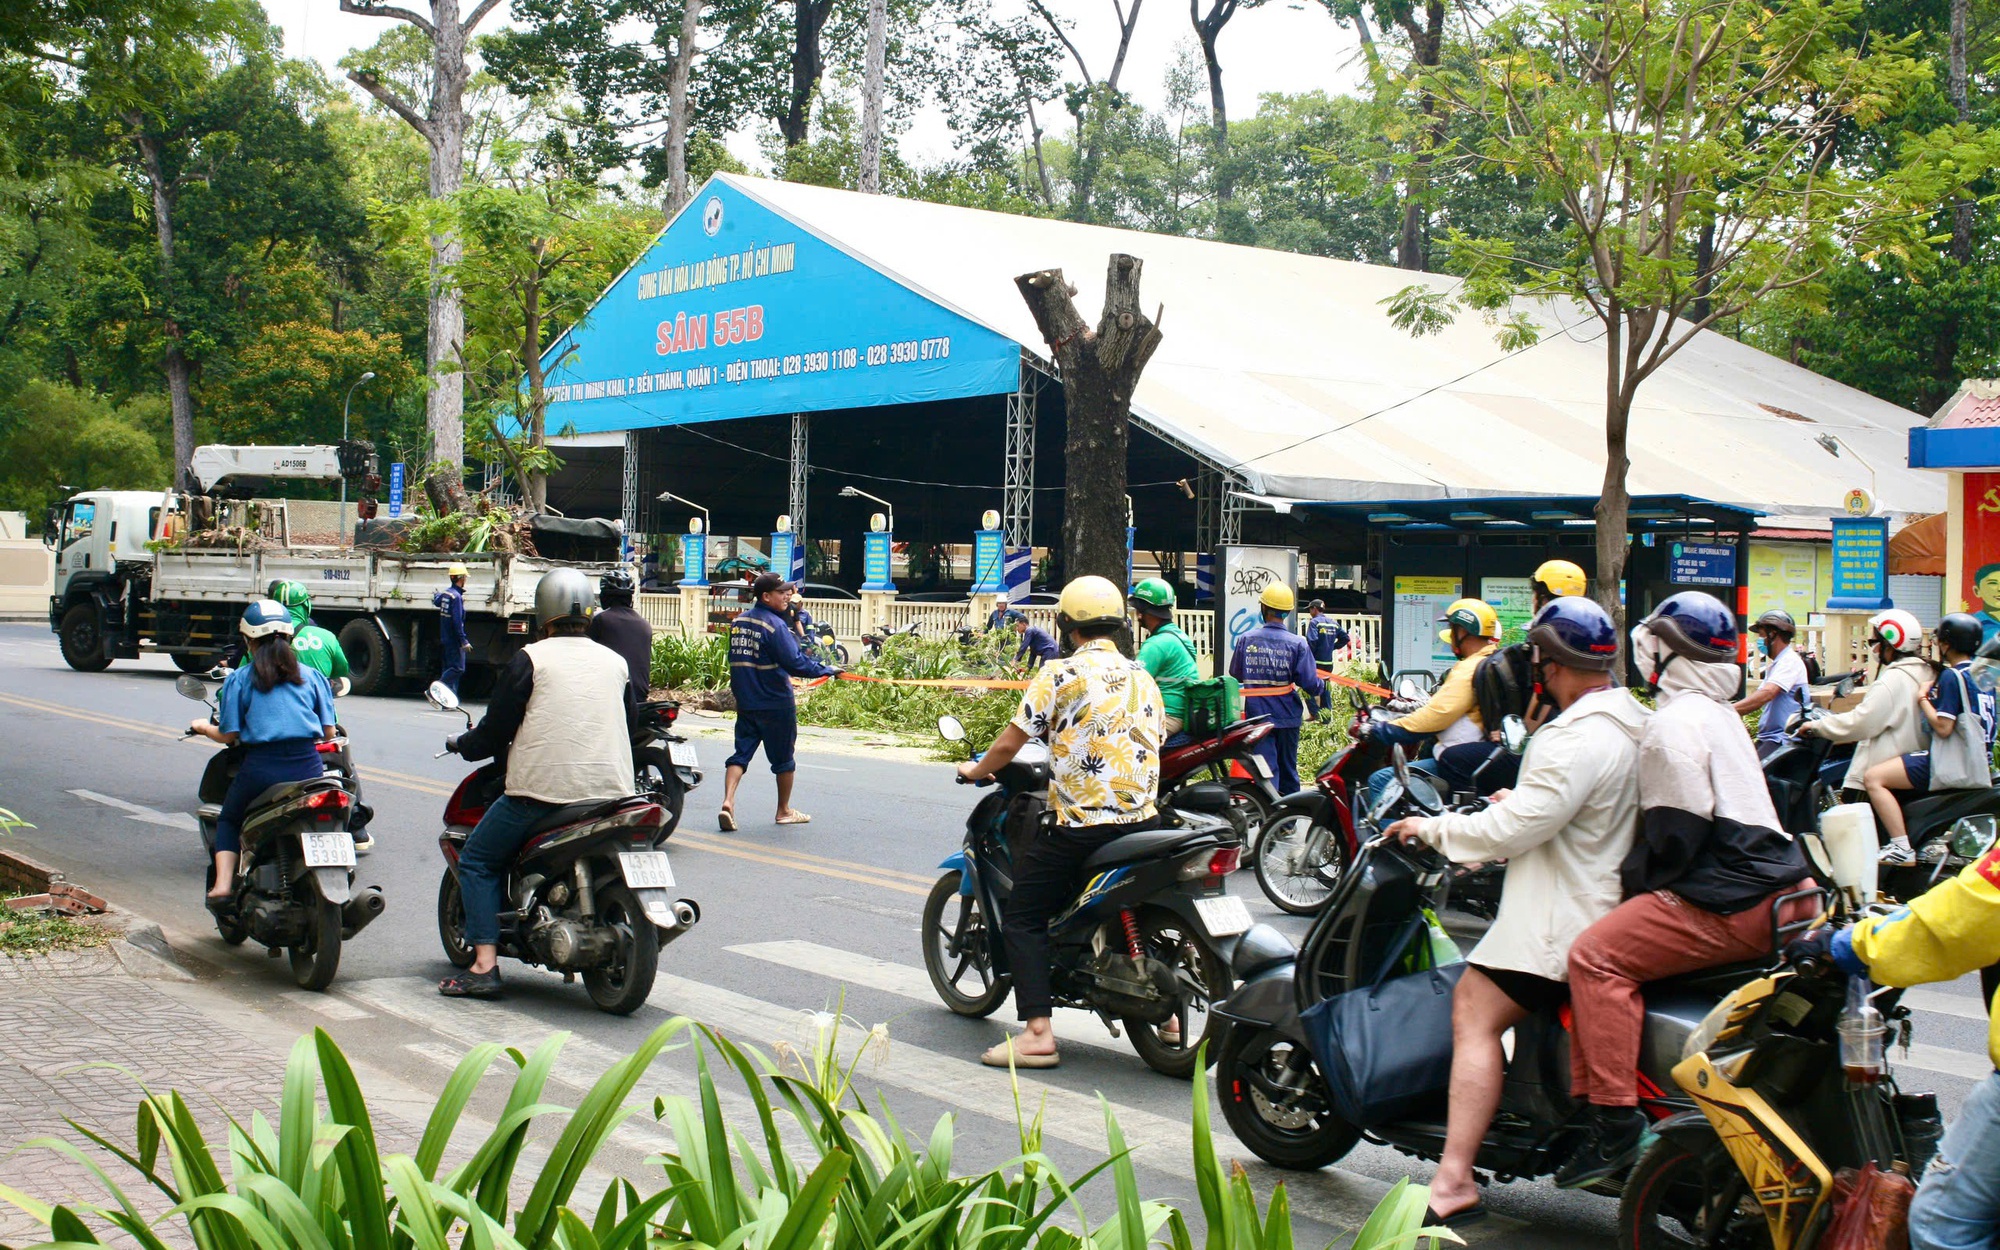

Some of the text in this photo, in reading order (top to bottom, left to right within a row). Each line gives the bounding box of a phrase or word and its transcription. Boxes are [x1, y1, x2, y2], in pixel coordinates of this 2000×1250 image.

[638, 271, 657, 300] CUNG
[658, 263, 673, 296] VĂN
[674, 261, 689, 294] HÓA
[690, 261, 705, 290] LAO
[706, 253, 728, 292] ĐỘNG
[729, 253, 740, 283] TP.
[755, 240, 771, 278] CHÍ
[771, 242, 796, 274] MINH
[656, 304, 764, 356] SÂN 55B
[572, 386, 583, 404] THỊ
[585, 381, 605, 400] MINH
[628, 377, 635, 395] P.
[637, 368, 653, 394] BẾN
[655, 368, 685, 392] THÀNH,
[686, 363, 711, 390] QUẬN
[713, 366, 718, 385] 1
[726, 358, 748, 386] ĐIỆN
[750, 356, 781, 382] THOẠI:
[783, 354, 801, 375] 028
[803, 349, 829, 374] 3930
[831, 347, 857, 371] 1108
[866, 344, 888, 366] 028
[889, 340, 918, 364] 3930
[920, 336, 951, 361] 9778
[1699, 548, 1730, 556] INFORMATION
[292, 632, 323, 650] ab
[312, 849, 348, 863] 5398
[632, 870, 667, 885] 0699
